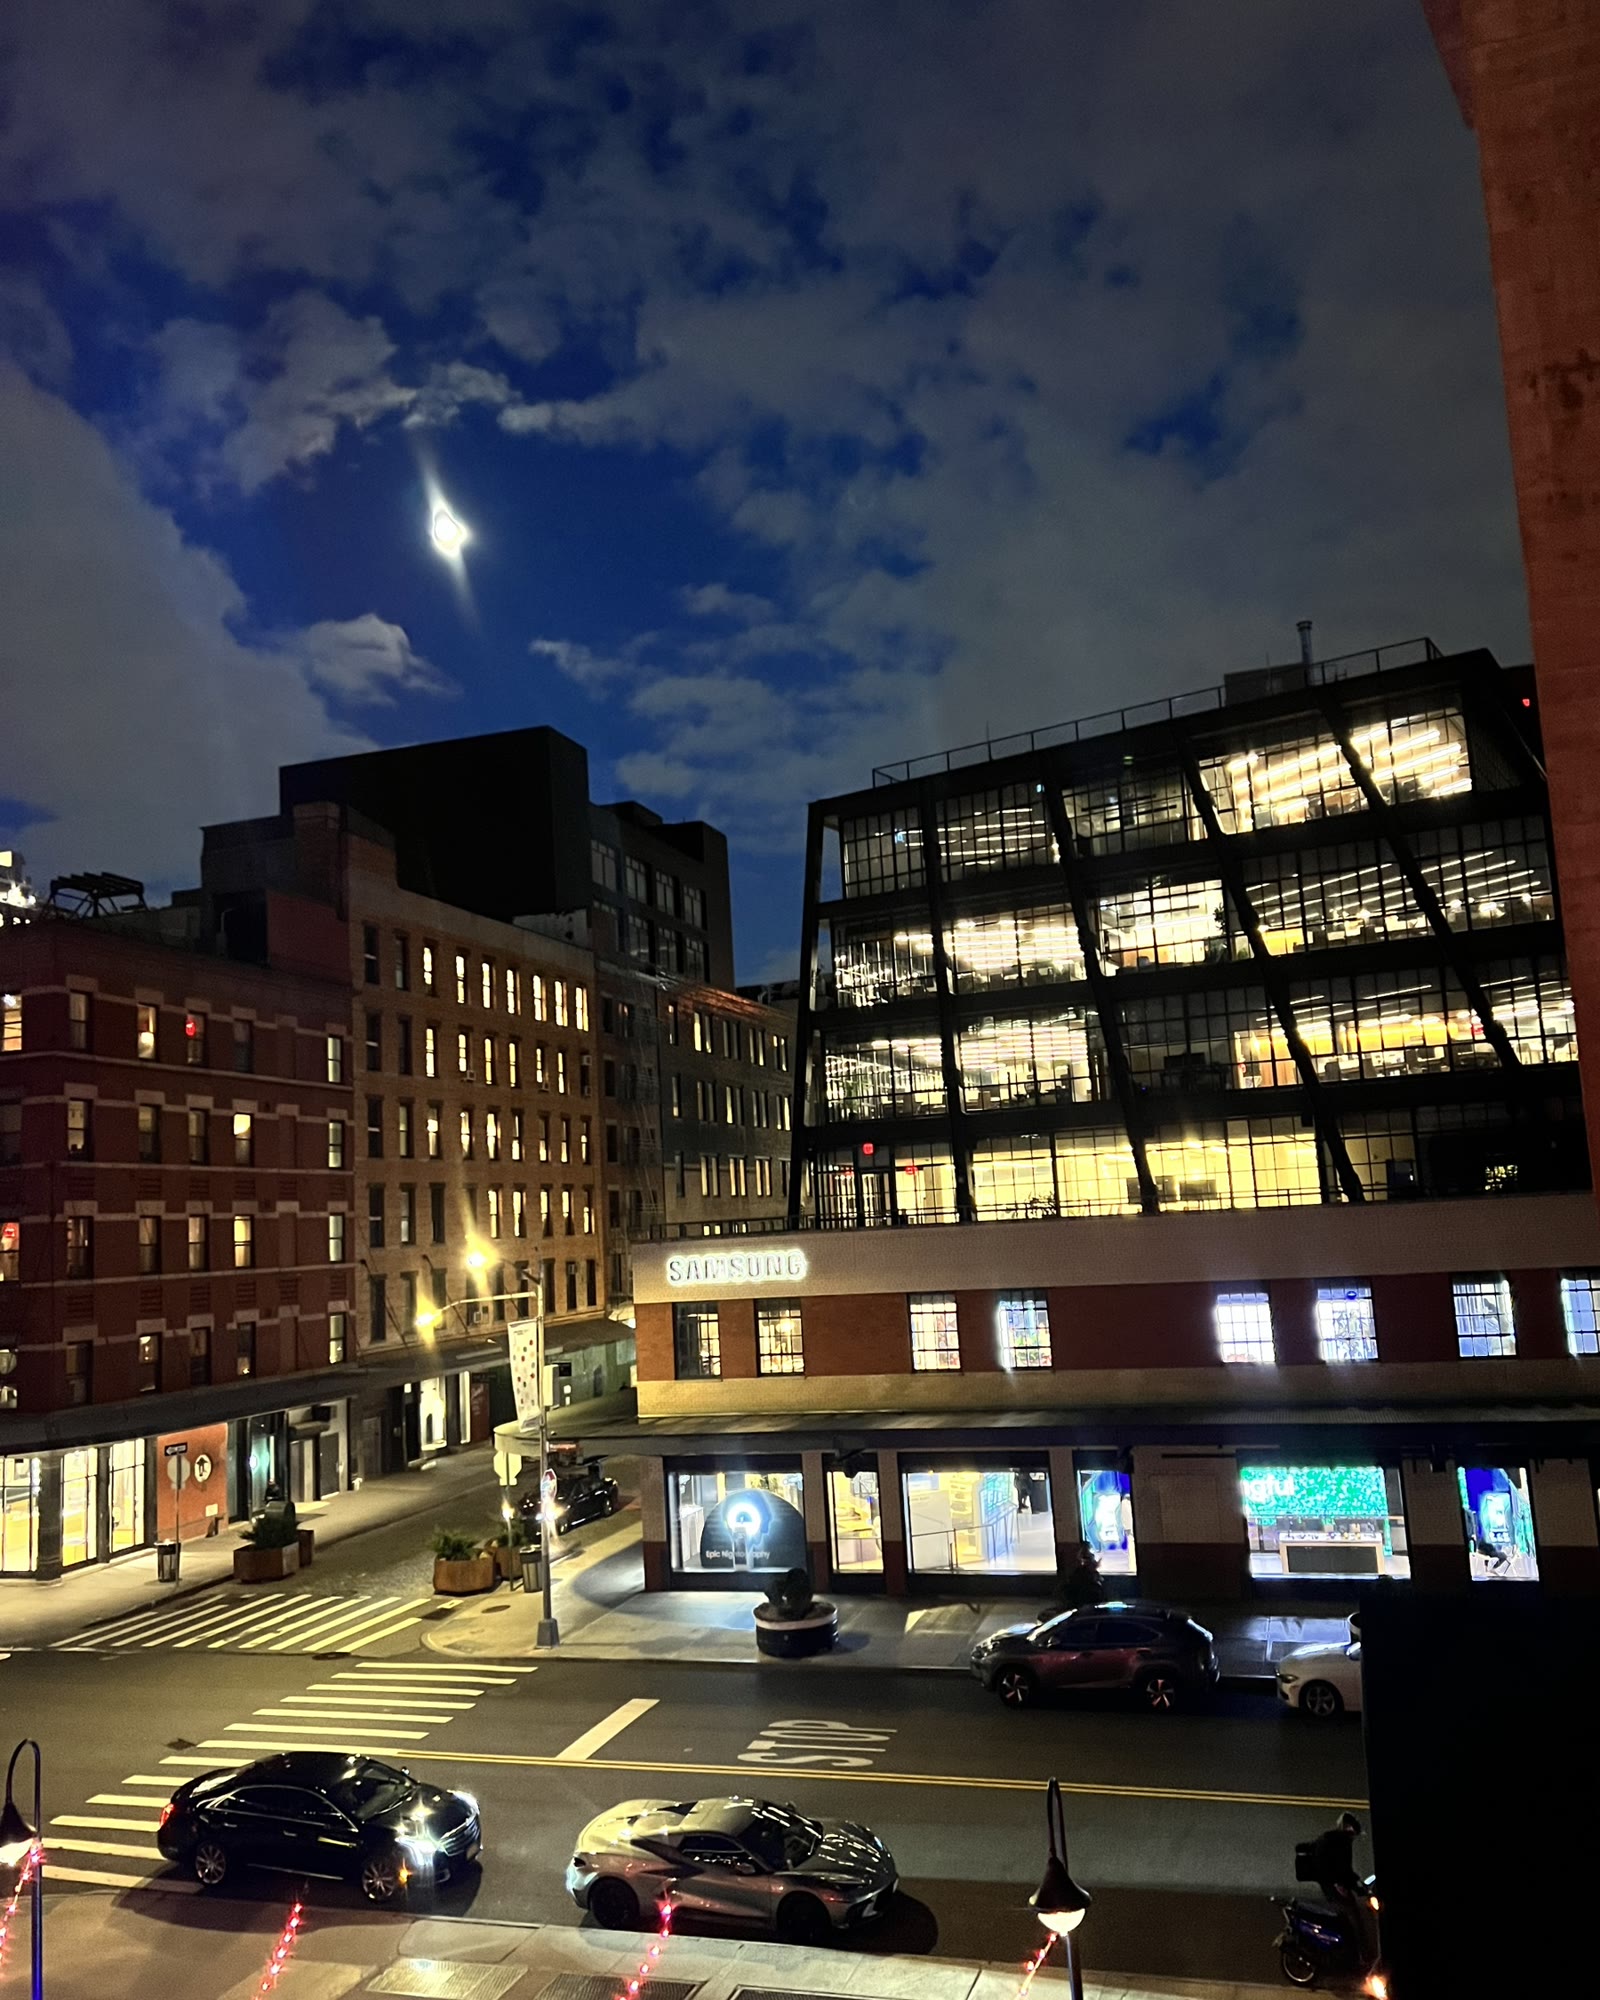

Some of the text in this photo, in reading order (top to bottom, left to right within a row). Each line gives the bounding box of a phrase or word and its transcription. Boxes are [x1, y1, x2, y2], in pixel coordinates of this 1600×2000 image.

[668, 1252, 802, 1283] SAMSUNG
[705, 1550, 770, 1560] Epic Nigtoaphy
[737, 1719, 898, 1767] STOP
